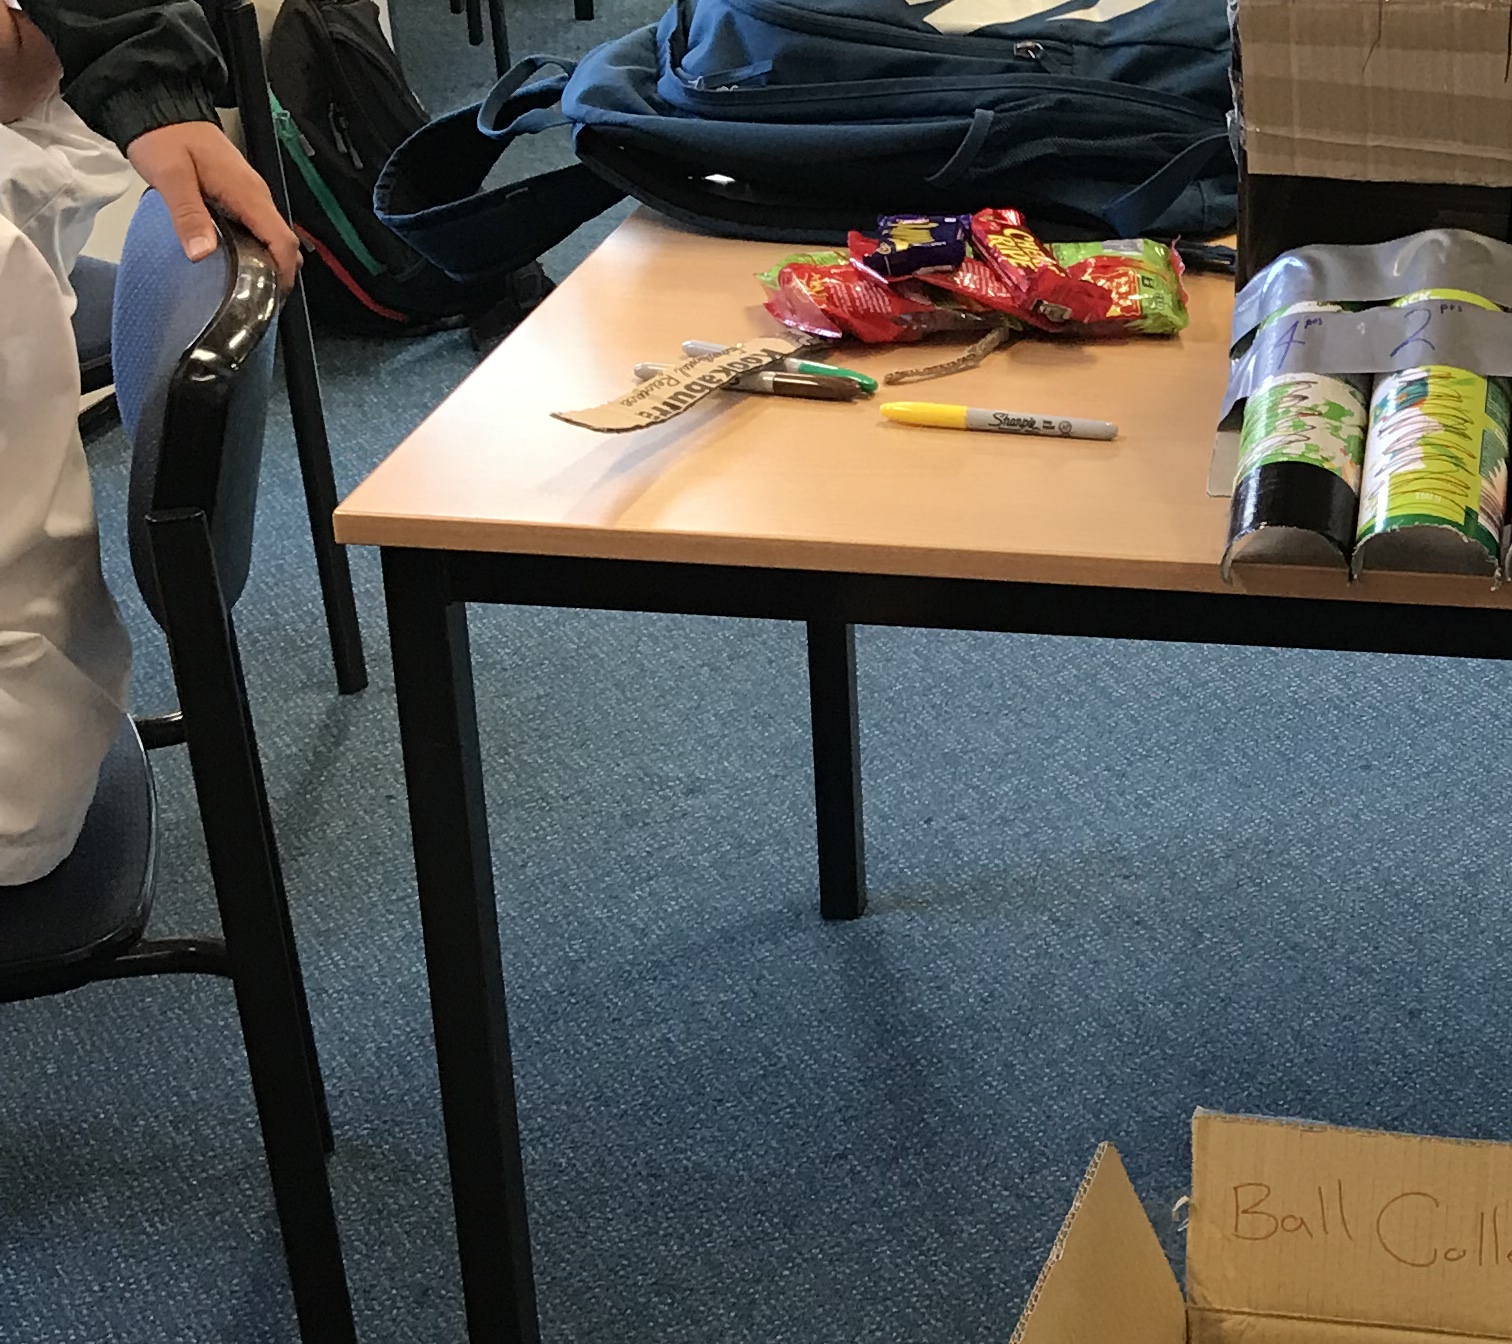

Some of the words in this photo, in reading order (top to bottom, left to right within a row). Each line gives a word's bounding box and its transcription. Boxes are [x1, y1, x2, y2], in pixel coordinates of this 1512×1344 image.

[1389, 307, 1436, 358] 2
[987, 411, 1041, 433] Sharpie
[1230, 1179, 1355, 1244] Ball
